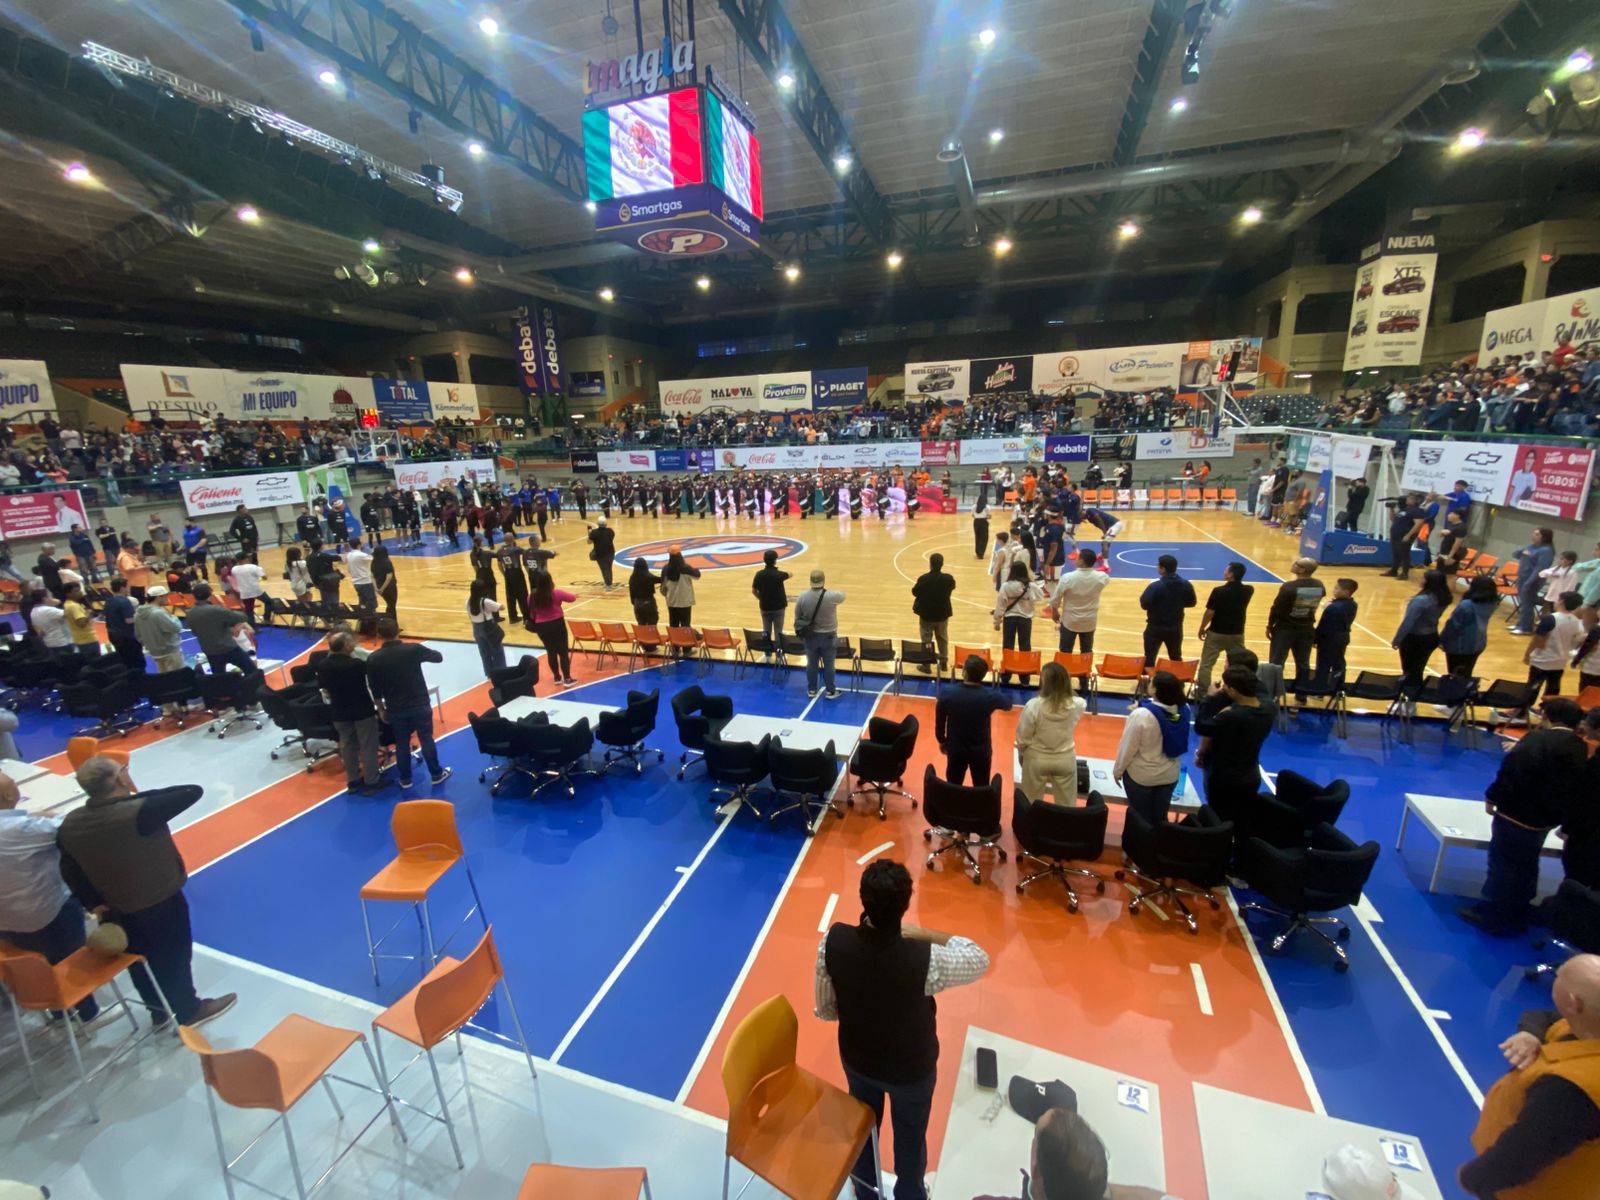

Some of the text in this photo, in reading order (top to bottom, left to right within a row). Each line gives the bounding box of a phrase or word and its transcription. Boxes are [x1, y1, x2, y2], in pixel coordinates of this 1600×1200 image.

[631, 201, 683, 216] Smartgas
[1387, 234, 1435, 249] NUEVA
[1393, 266, 1421, 279] XT5
[1500, 327, 1532, 345] MEGA
[389, 386, 419, 400] TOTAL
[764, 386, 806, 398] Provelim
[830, 382, 865, 392] PIAGET
[243, 390, 297, 413] MI EQUIPO
[1053, 444, 1088, 454] debate
[1407, 468, 1446, 479] CADILLAC
[1461, 467, 1499, 475] CHEVROLET
[1466, 481, 1494, 494] ÉLIX
[1543, 475, 1578, 488] LOBOS!
[1127, 1086, 1142, 1100] 12
[1393, 1143, 1409, 1159] 13
